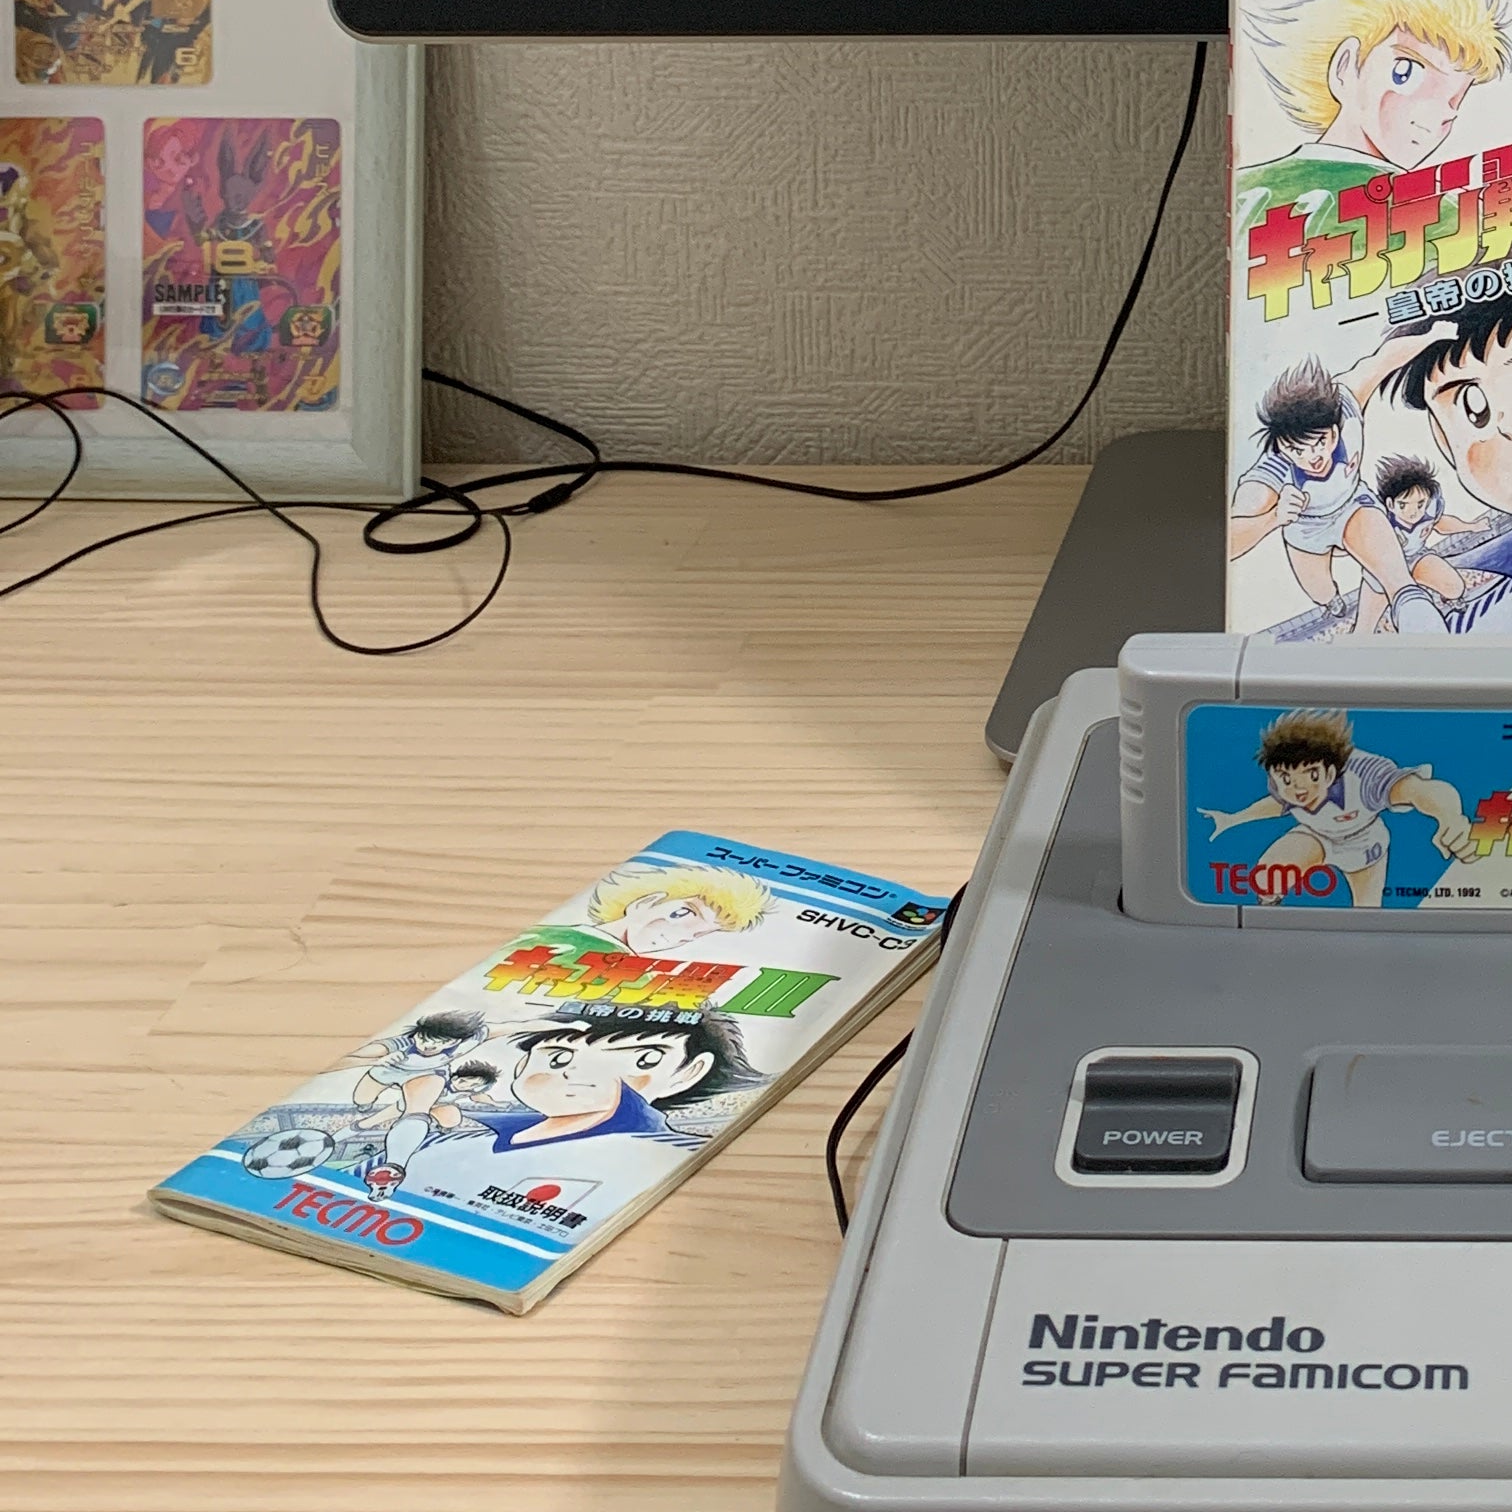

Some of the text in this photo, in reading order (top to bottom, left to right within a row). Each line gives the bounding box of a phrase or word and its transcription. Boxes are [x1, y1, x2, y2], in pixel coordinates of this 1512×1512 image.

[155, 284, 222, 303] SAMPLE
[706, 846, 779, 870] スーパー
[1209, 862, 1339, 897] TECMO
[1457, 887, 1481, 897] 1992
[1102, 1128, 1205, 1147] POWER
[273, 1182, 424, 1246] TECMO
[477, 1185, 588, 1229] 取扱説明書
[1028, 1314, 1325, 1353] Nintendo
[1022, 1361, 1469, 1390] SUPER FAMICOM
